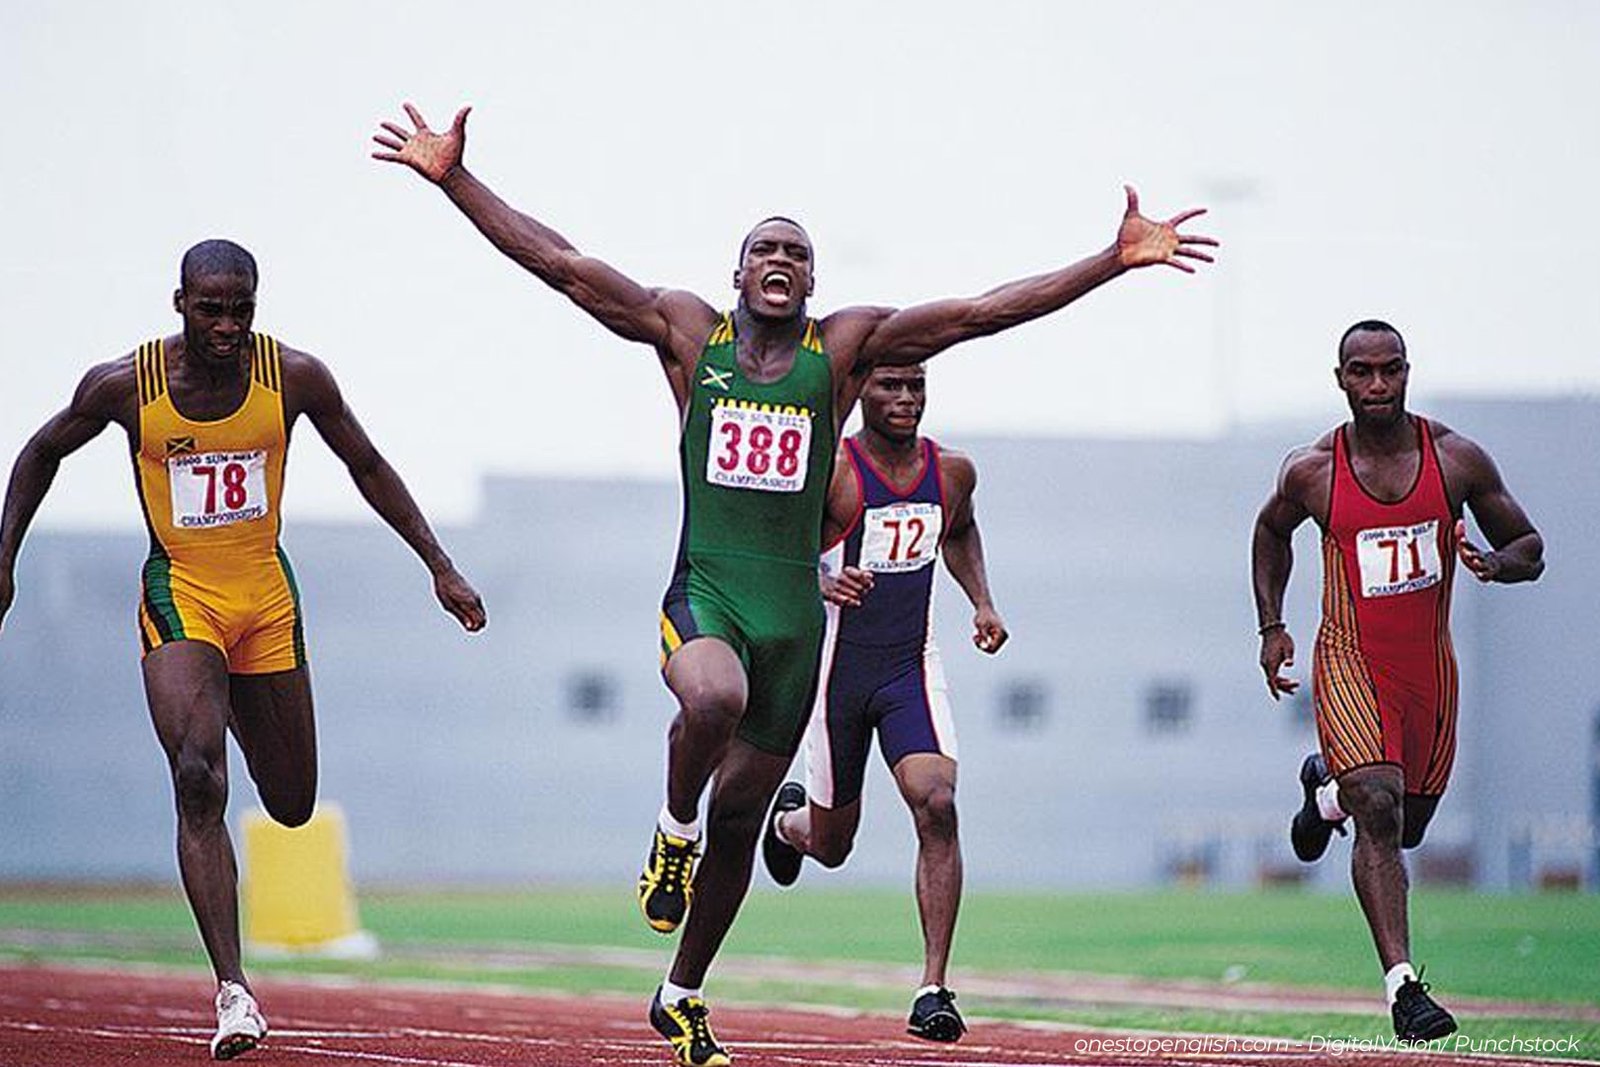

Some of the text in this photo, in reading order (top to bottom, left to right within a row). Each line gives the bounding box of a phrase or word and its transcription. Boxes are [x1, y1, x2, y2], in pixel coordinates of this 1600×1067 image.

[717, 422, 802, 477] 388
[192, 463, 247, 514] 78
[883, 518, 925, 560] 72
[1378, 537, 1426, 583] 71
